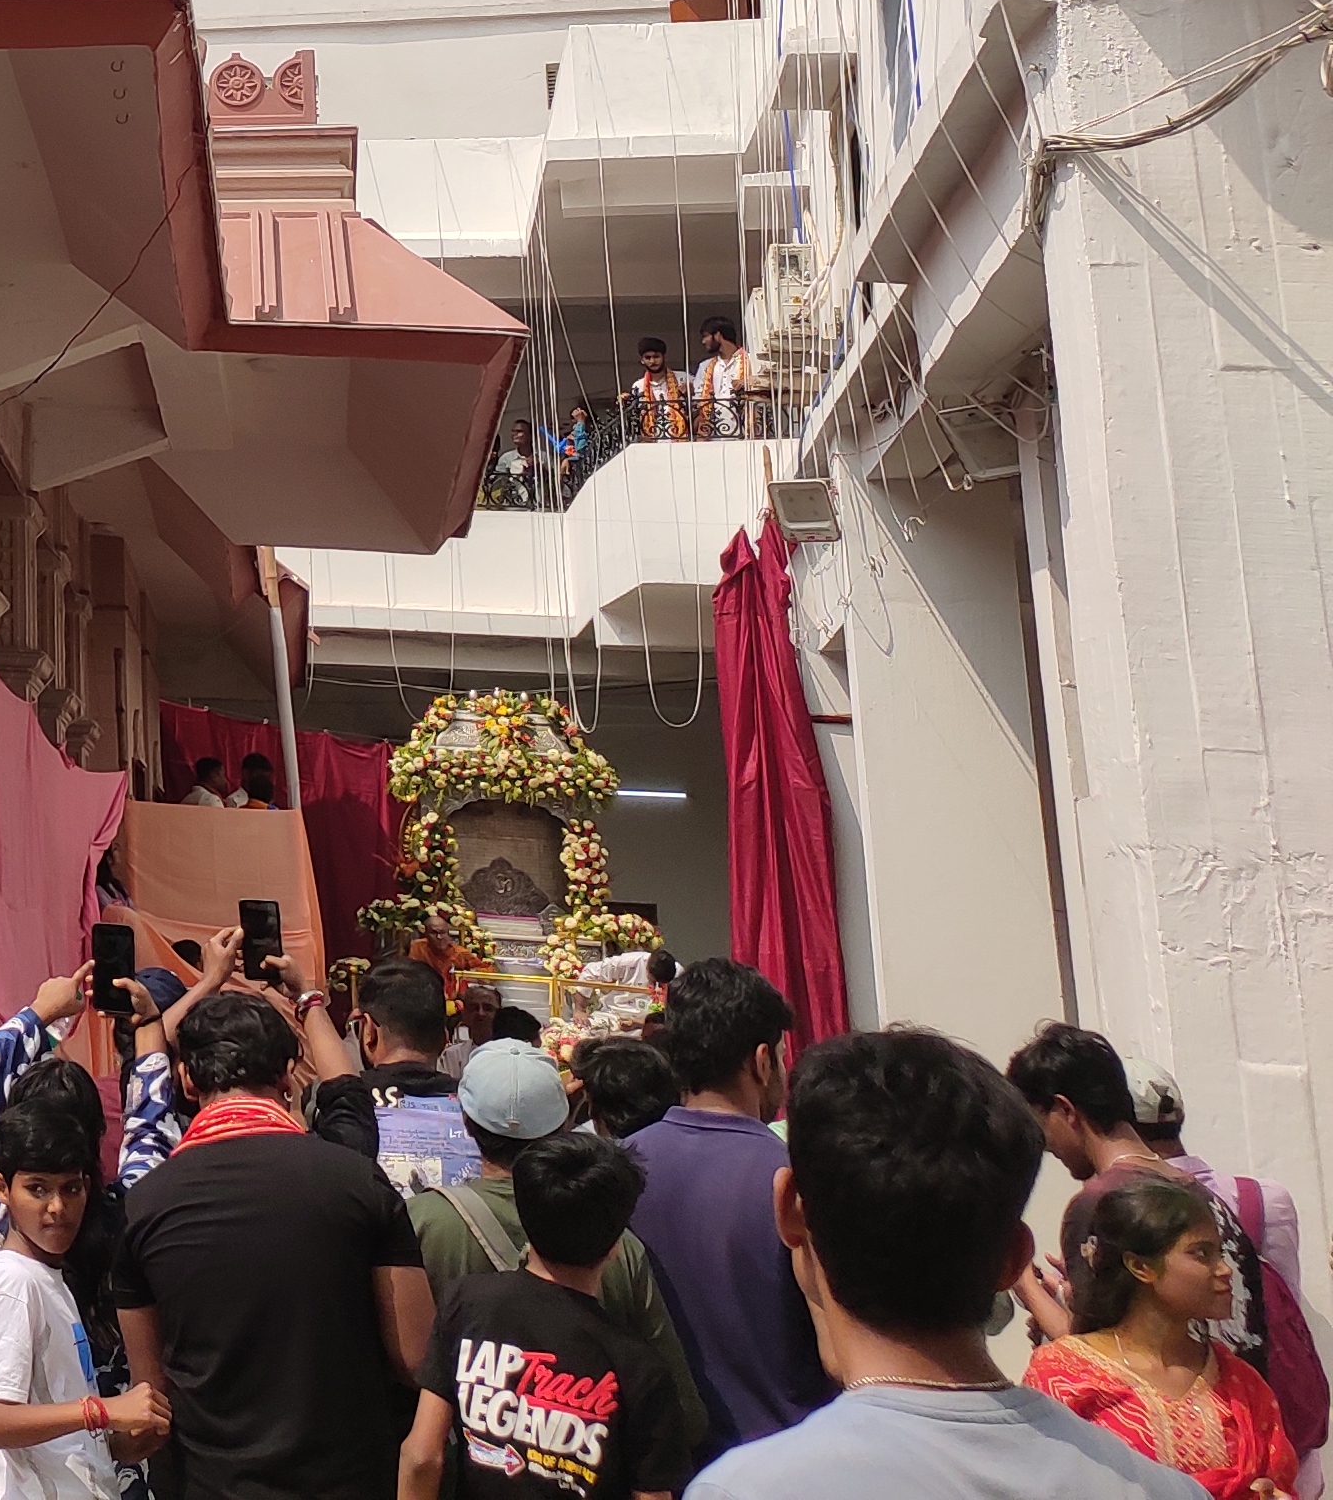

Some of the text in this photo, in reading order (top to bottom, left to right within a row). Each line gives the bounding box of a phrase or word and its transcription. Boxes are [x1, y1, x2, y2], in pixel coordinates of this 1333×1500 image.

[456, 1338, 619, 1418] LAP Track
[458, 1382, 609, 1467] LEGENDS
